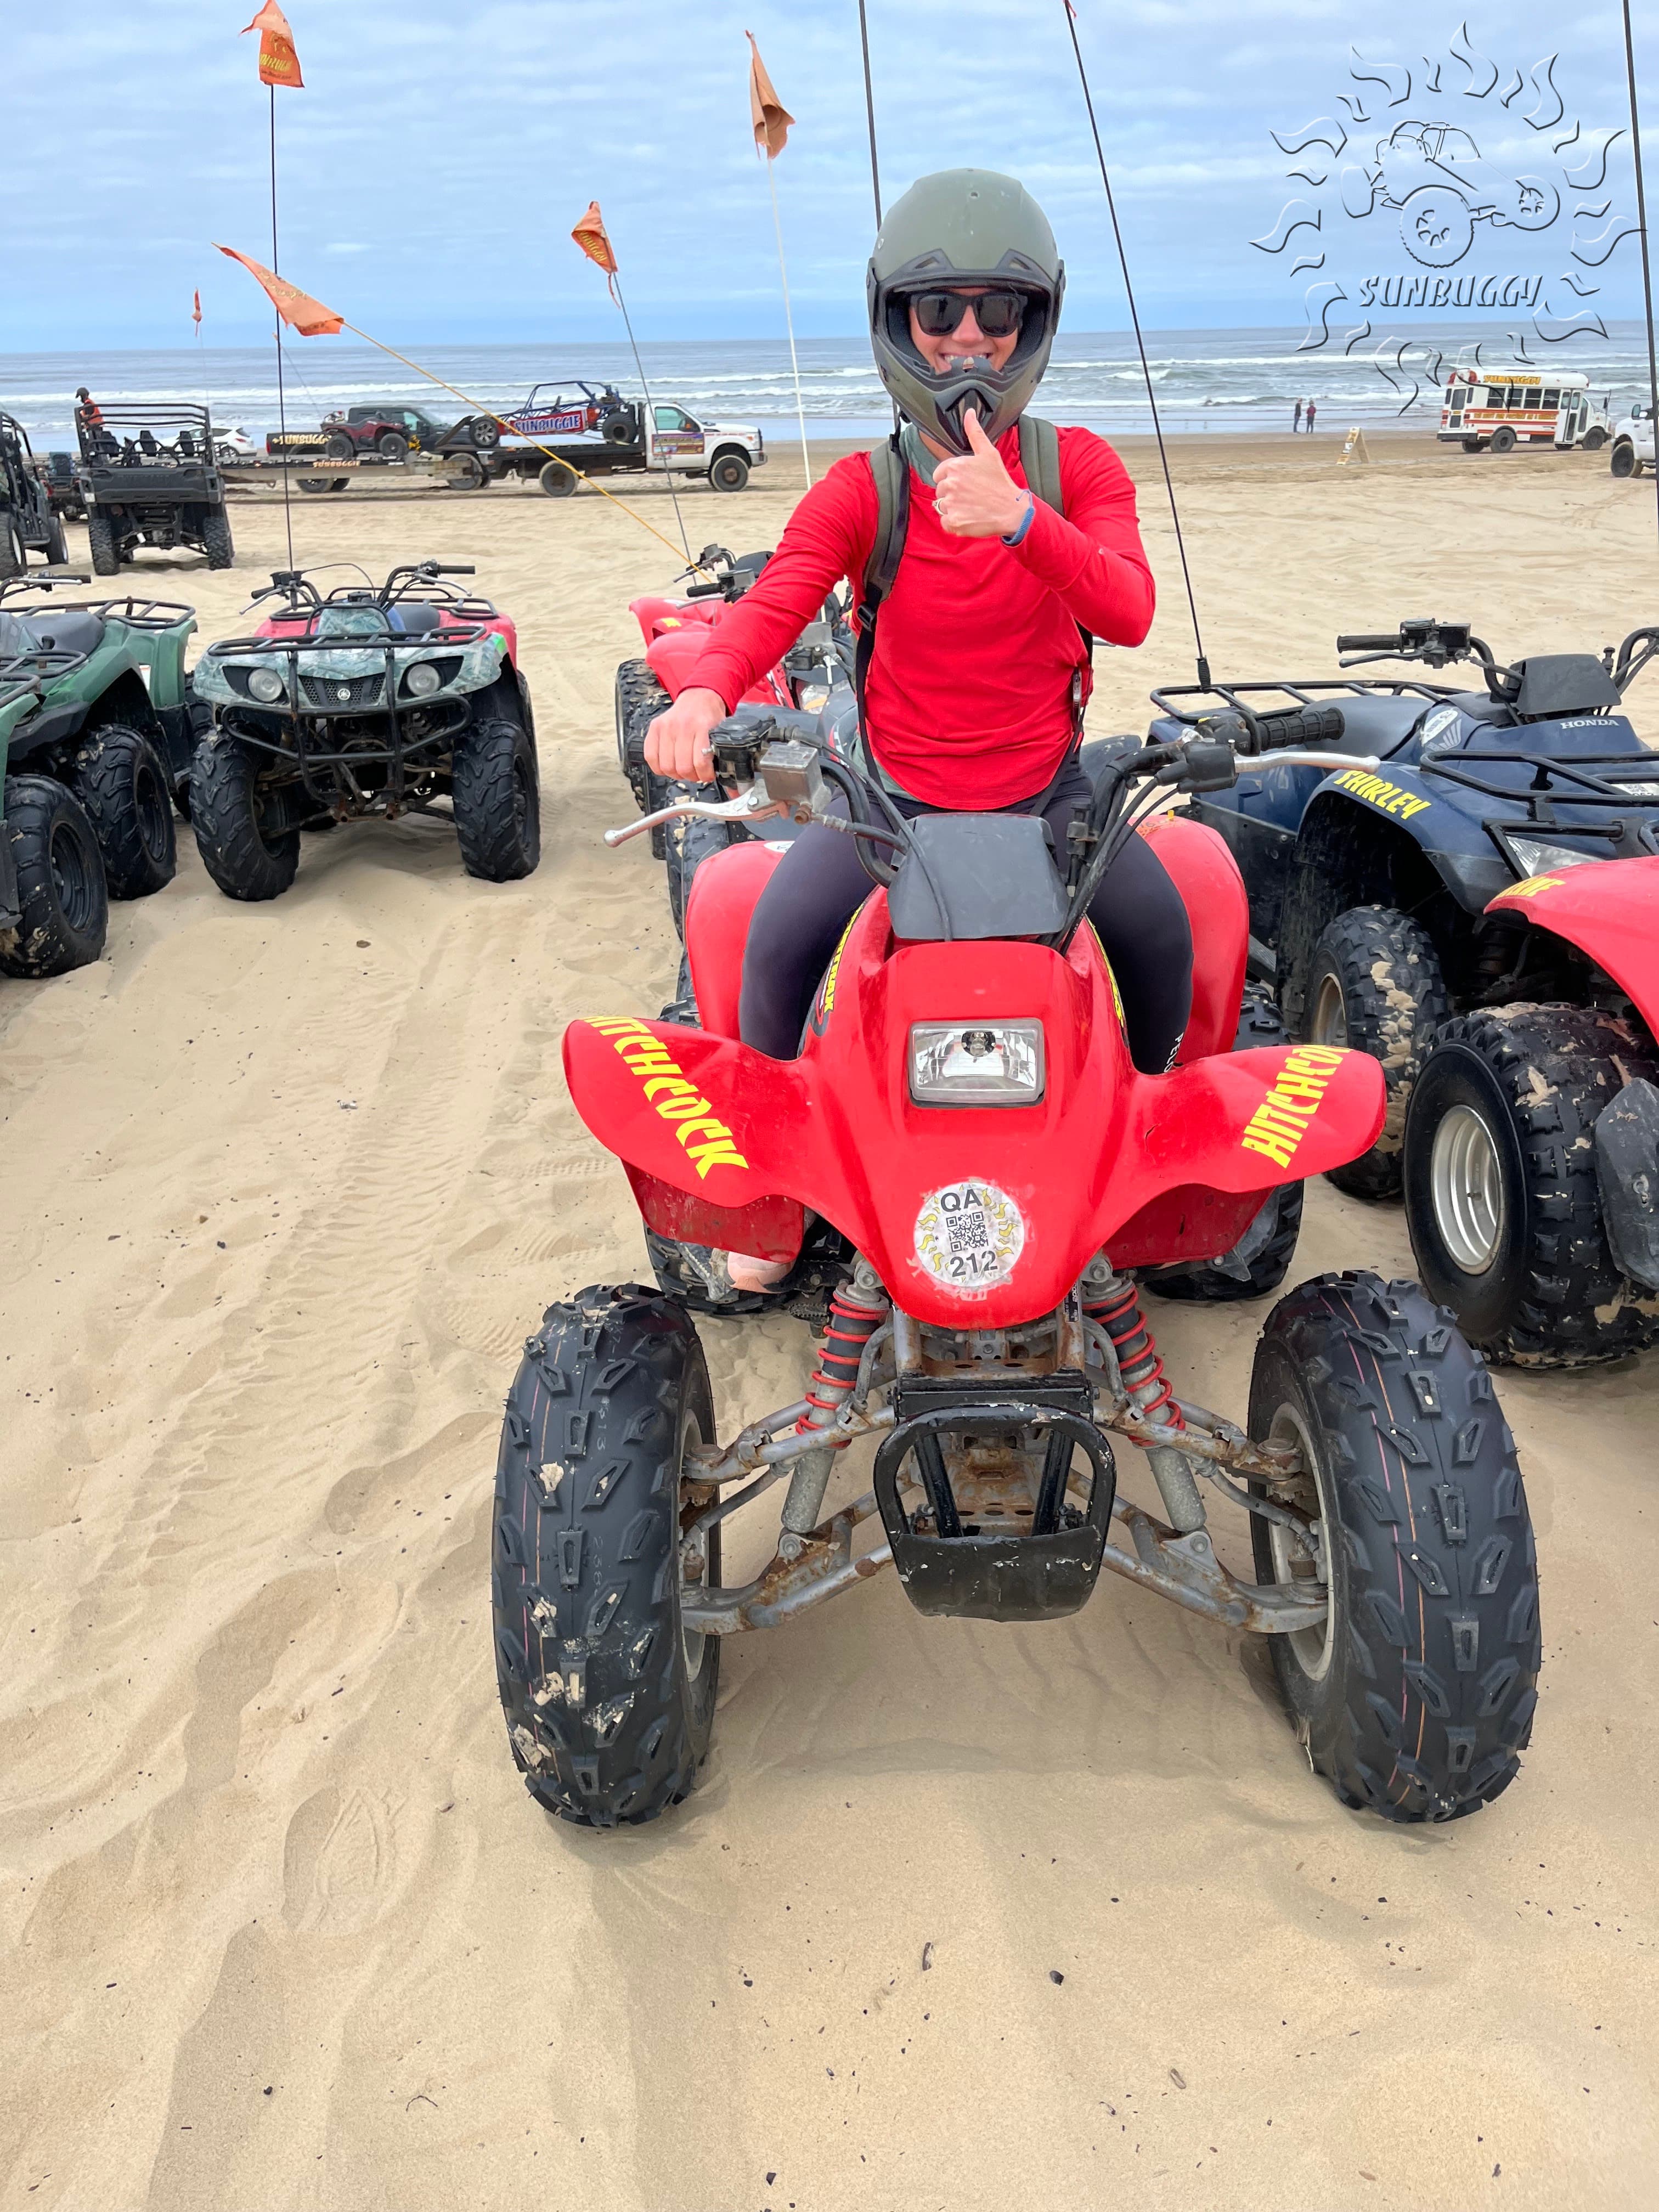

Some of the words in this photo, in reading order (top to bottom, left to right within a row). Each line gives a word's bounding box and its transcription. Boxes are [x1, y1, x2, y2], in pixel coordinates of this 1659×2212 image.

[279, 434, 331, 445] SUNBUGG
[1560, 719, 1620, 729] HONDA
[1333, 770, 1432, 820] SHIRLEY
[941, 1189, 983, 1212] QA
[950, 1250, 998, 1278] 212
